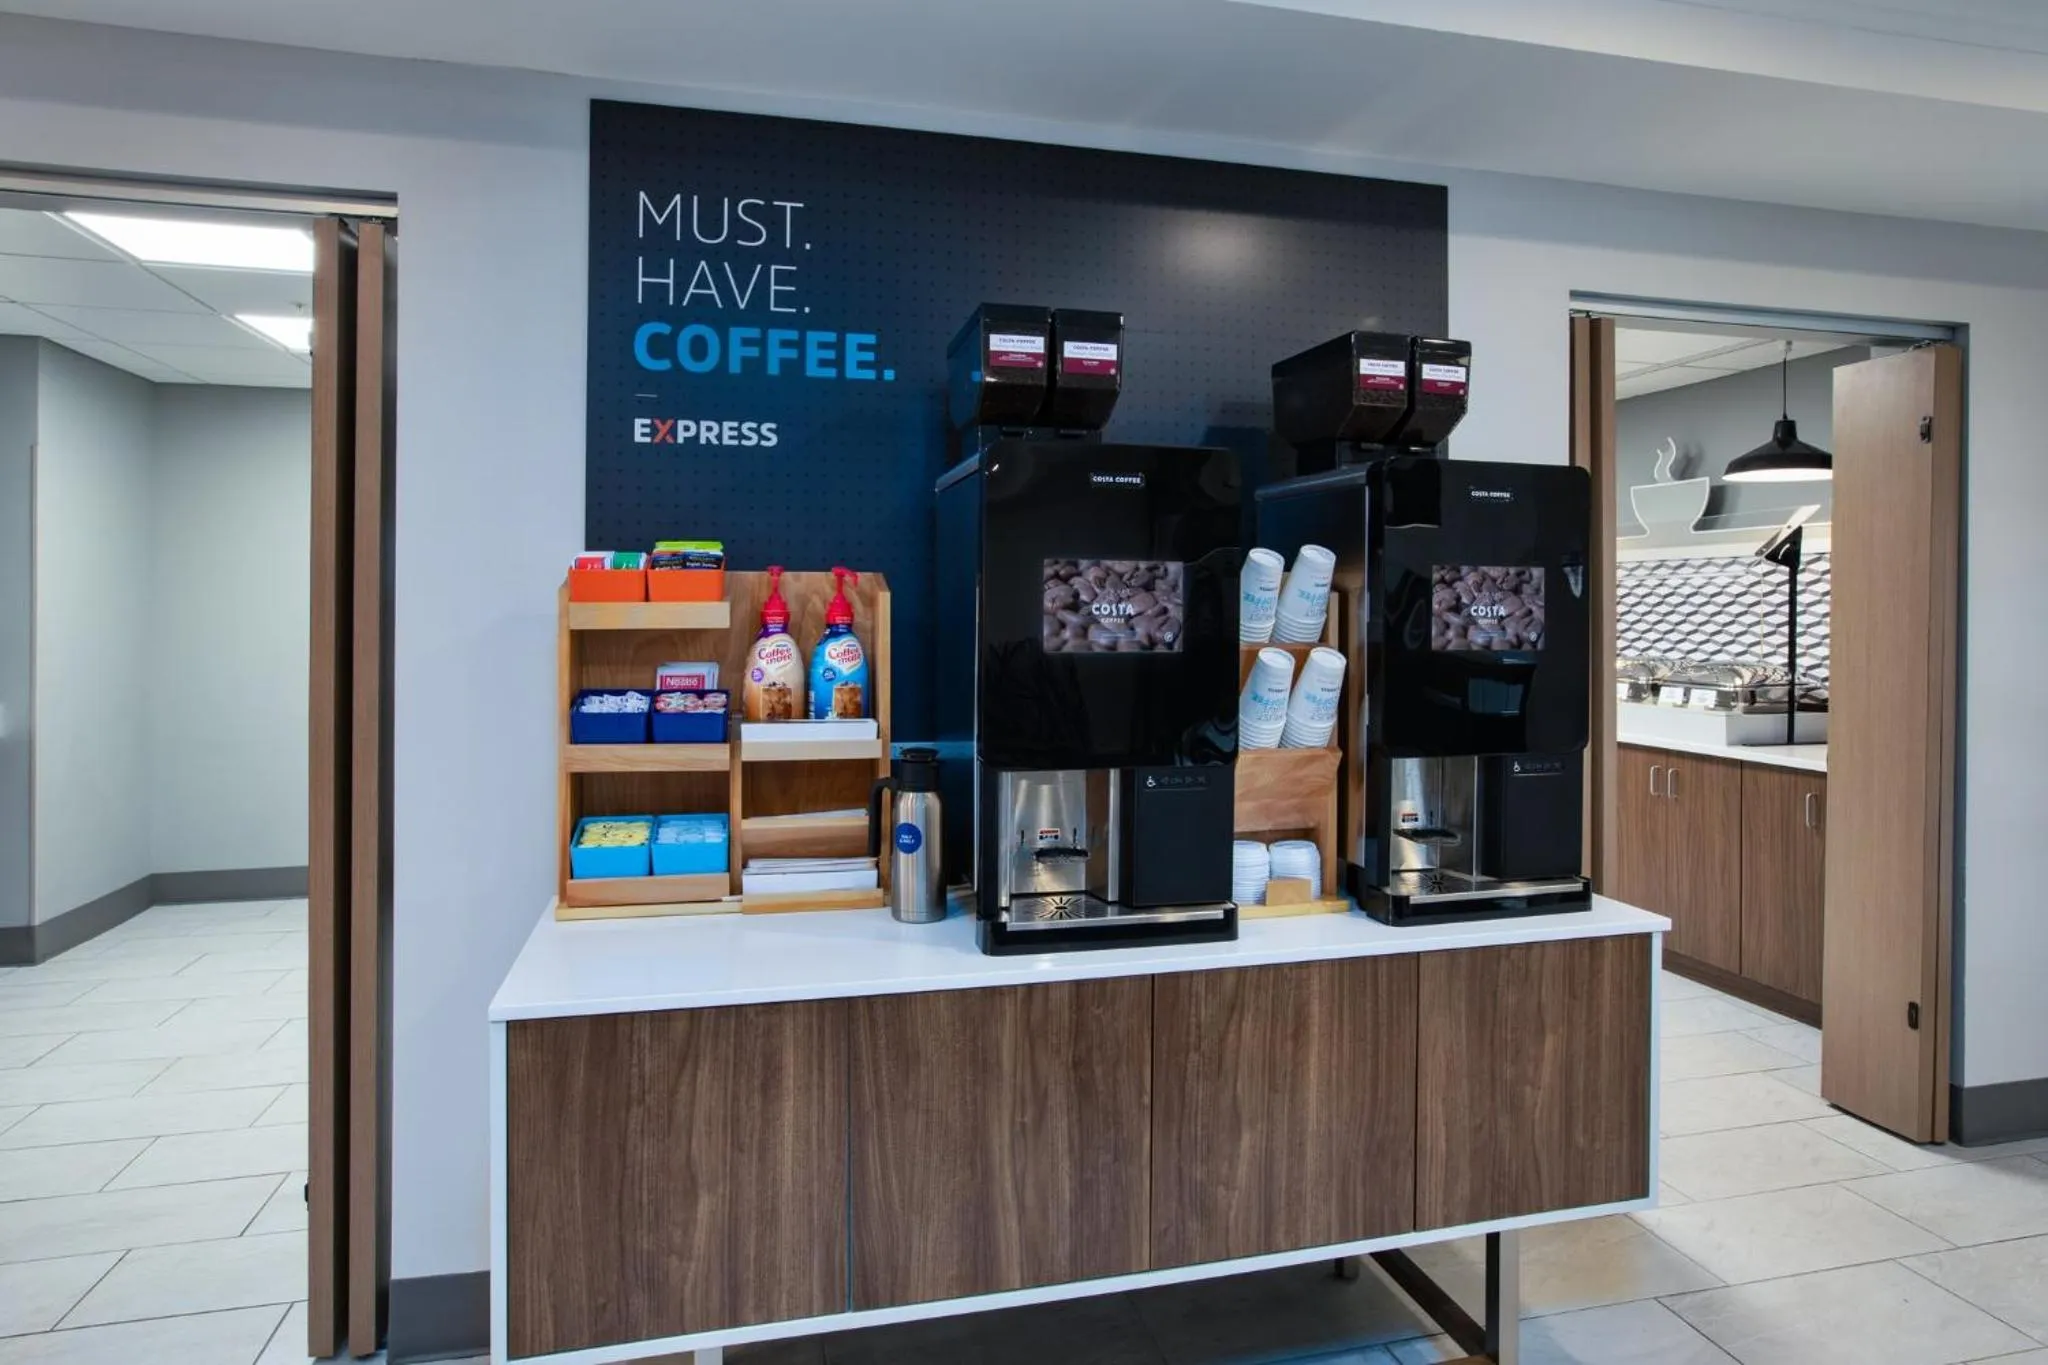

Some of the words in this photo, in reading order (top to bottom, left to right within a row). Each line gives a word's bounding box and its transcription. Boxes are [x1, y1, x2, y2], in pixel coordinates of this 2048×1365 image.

[636, 190, 813, 251] MUST.
[636, 256, 811, 314] HAVE.
[633, 321, 895, 381] COFFEE.
[633, 417, 779, 448] EXPRESS
[1092, 475, 1114, 483] COSTA
[1115, 476, 1141, 484] COFFEE
[1091, 603, 1135, 616] COSTA
[1470, 605, 1507, 618] COSTA
[758, 646, 792, 660] Coffee
[828, 647, 861, 660] Coffee
